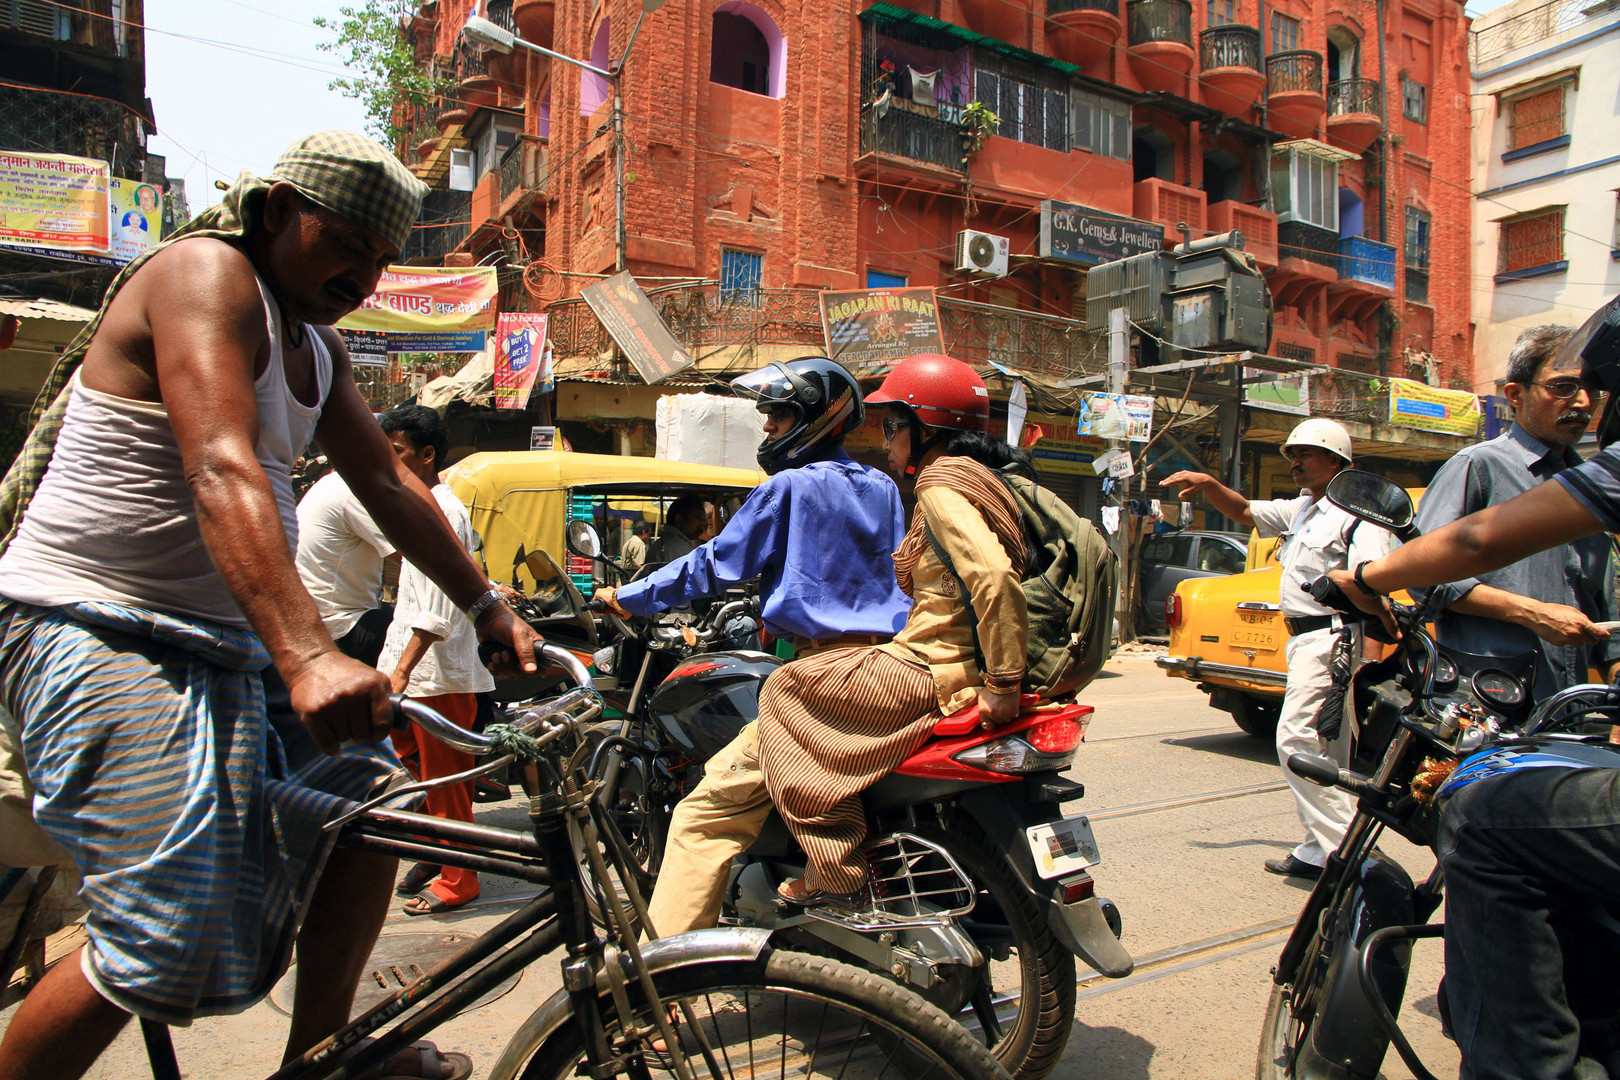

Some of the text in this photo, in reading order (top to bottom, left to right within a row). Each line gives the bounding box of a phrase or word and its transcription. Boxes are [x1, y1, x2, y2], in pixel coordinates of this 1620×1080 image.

[1054, 212, 1078, 233] G.K.
[1080, 217, 1108, 239] Gems
[1108, 226, 1117, 241] &
[1120, 227, 1160, 250] Jewellery
[389, 292, 432, 315] ब्राण्ड
[436, 302, 455, 315] शुद्ध
[828, 296, 934, 324] JAGARAN KI RAAT
[600, 282, 637, 327] SALASAR
[633, 326, 671, 374] RHODIUM
[511, 335, 523, 346] BUY
[867, 341, 897, 349] Arranged
[512, 344, 529, 357] GET 2
[839, 350, 881, 362] SEALDAH
[884, 348, 909, 359] AMRA
